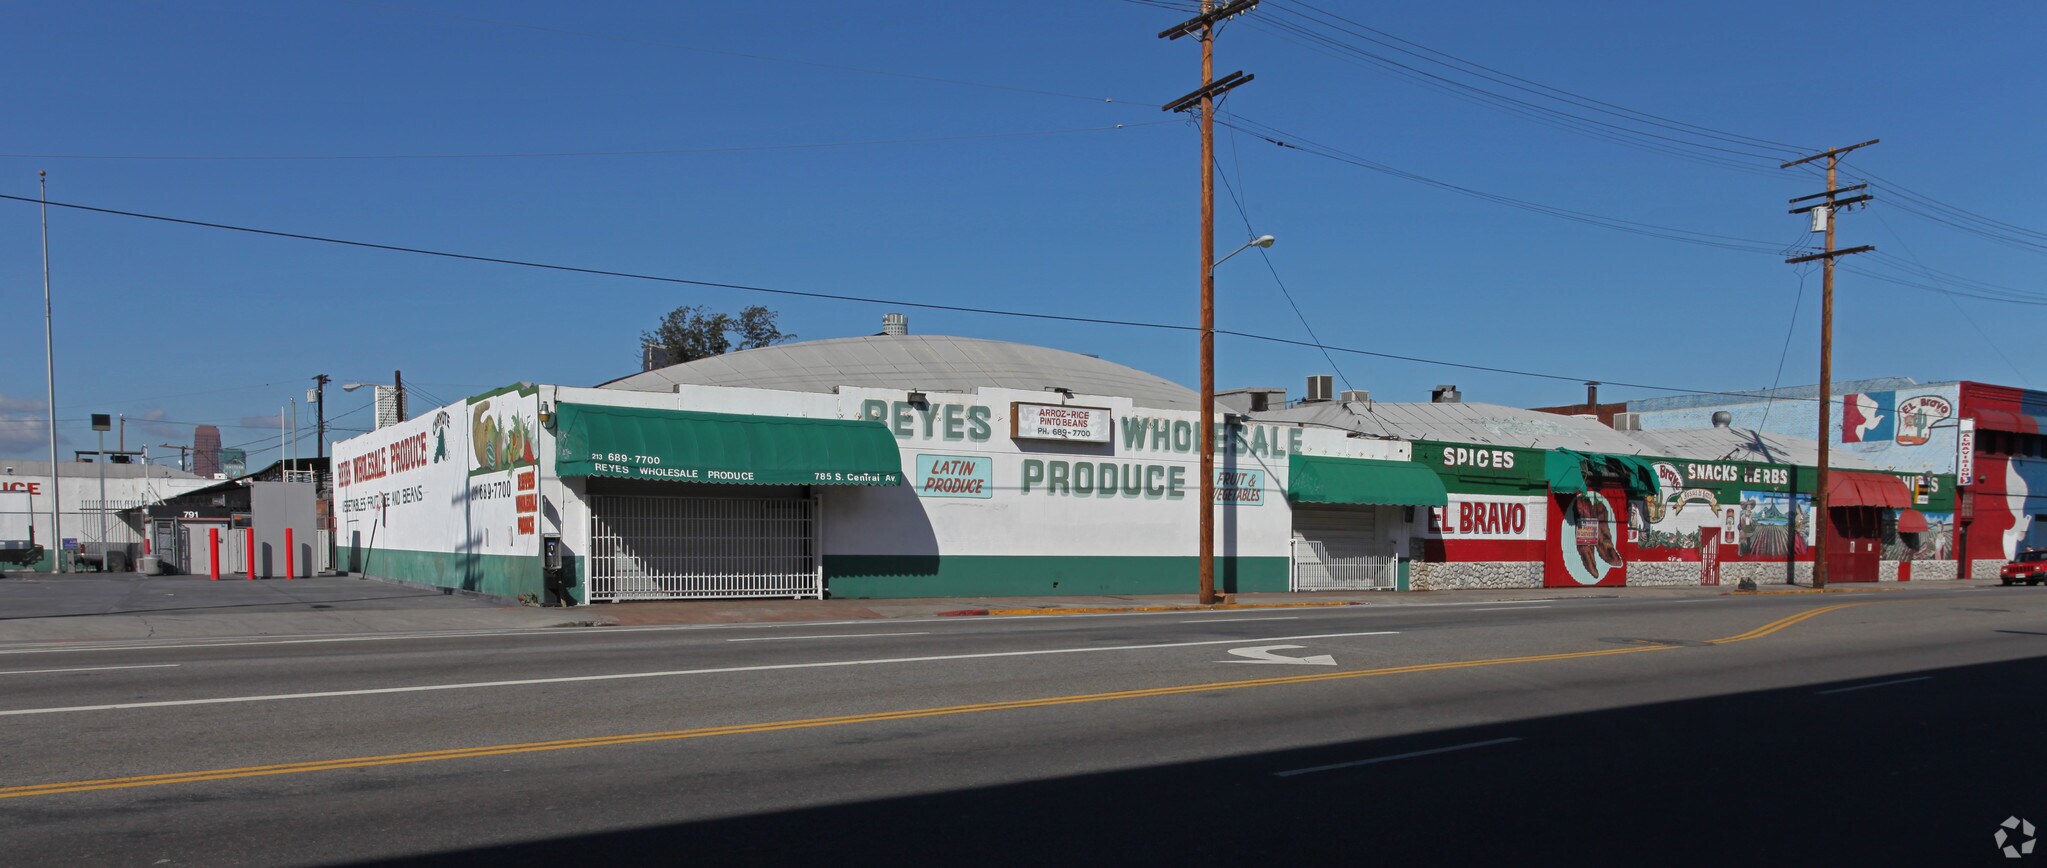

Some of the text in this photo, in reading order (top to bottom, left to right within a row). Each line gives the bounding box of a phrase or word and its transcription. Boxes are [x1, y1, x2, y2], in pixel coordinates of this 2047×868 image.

[861, 398, 991, 442] REYES
[1039, 408, 1089, 420] ARROZ-RICE
[1040, 418, 1088, 428] PINTO BEANS
[1038, 428, 1090, 438] PH. 689-7700
[353, 446, 386, 484] WHOLESALE
[390, 431, 427, 474] PRODUCE
[1444, 447, 1514, 468] SPICES
[595, 462, 754, 480] REYES WHOLESALE PRODUCE
[814, 472, 832, 480] 785
[835, 472, 844, 481] S.
[932, 459, 976, 476] LATIN
[1688, 463, 1738, 482] SNACKS
[924, 476, 984, 494] PRODUCE
[1020, 458, 1185, 500] PRODUCE
[1216, 472, 1256, 488] FRUIT &
[402, 485, 422, 504] BEANS
[480, 480, 512, 500] 689-7700
[1428, 502, 1526, 534] EL BRAVO
